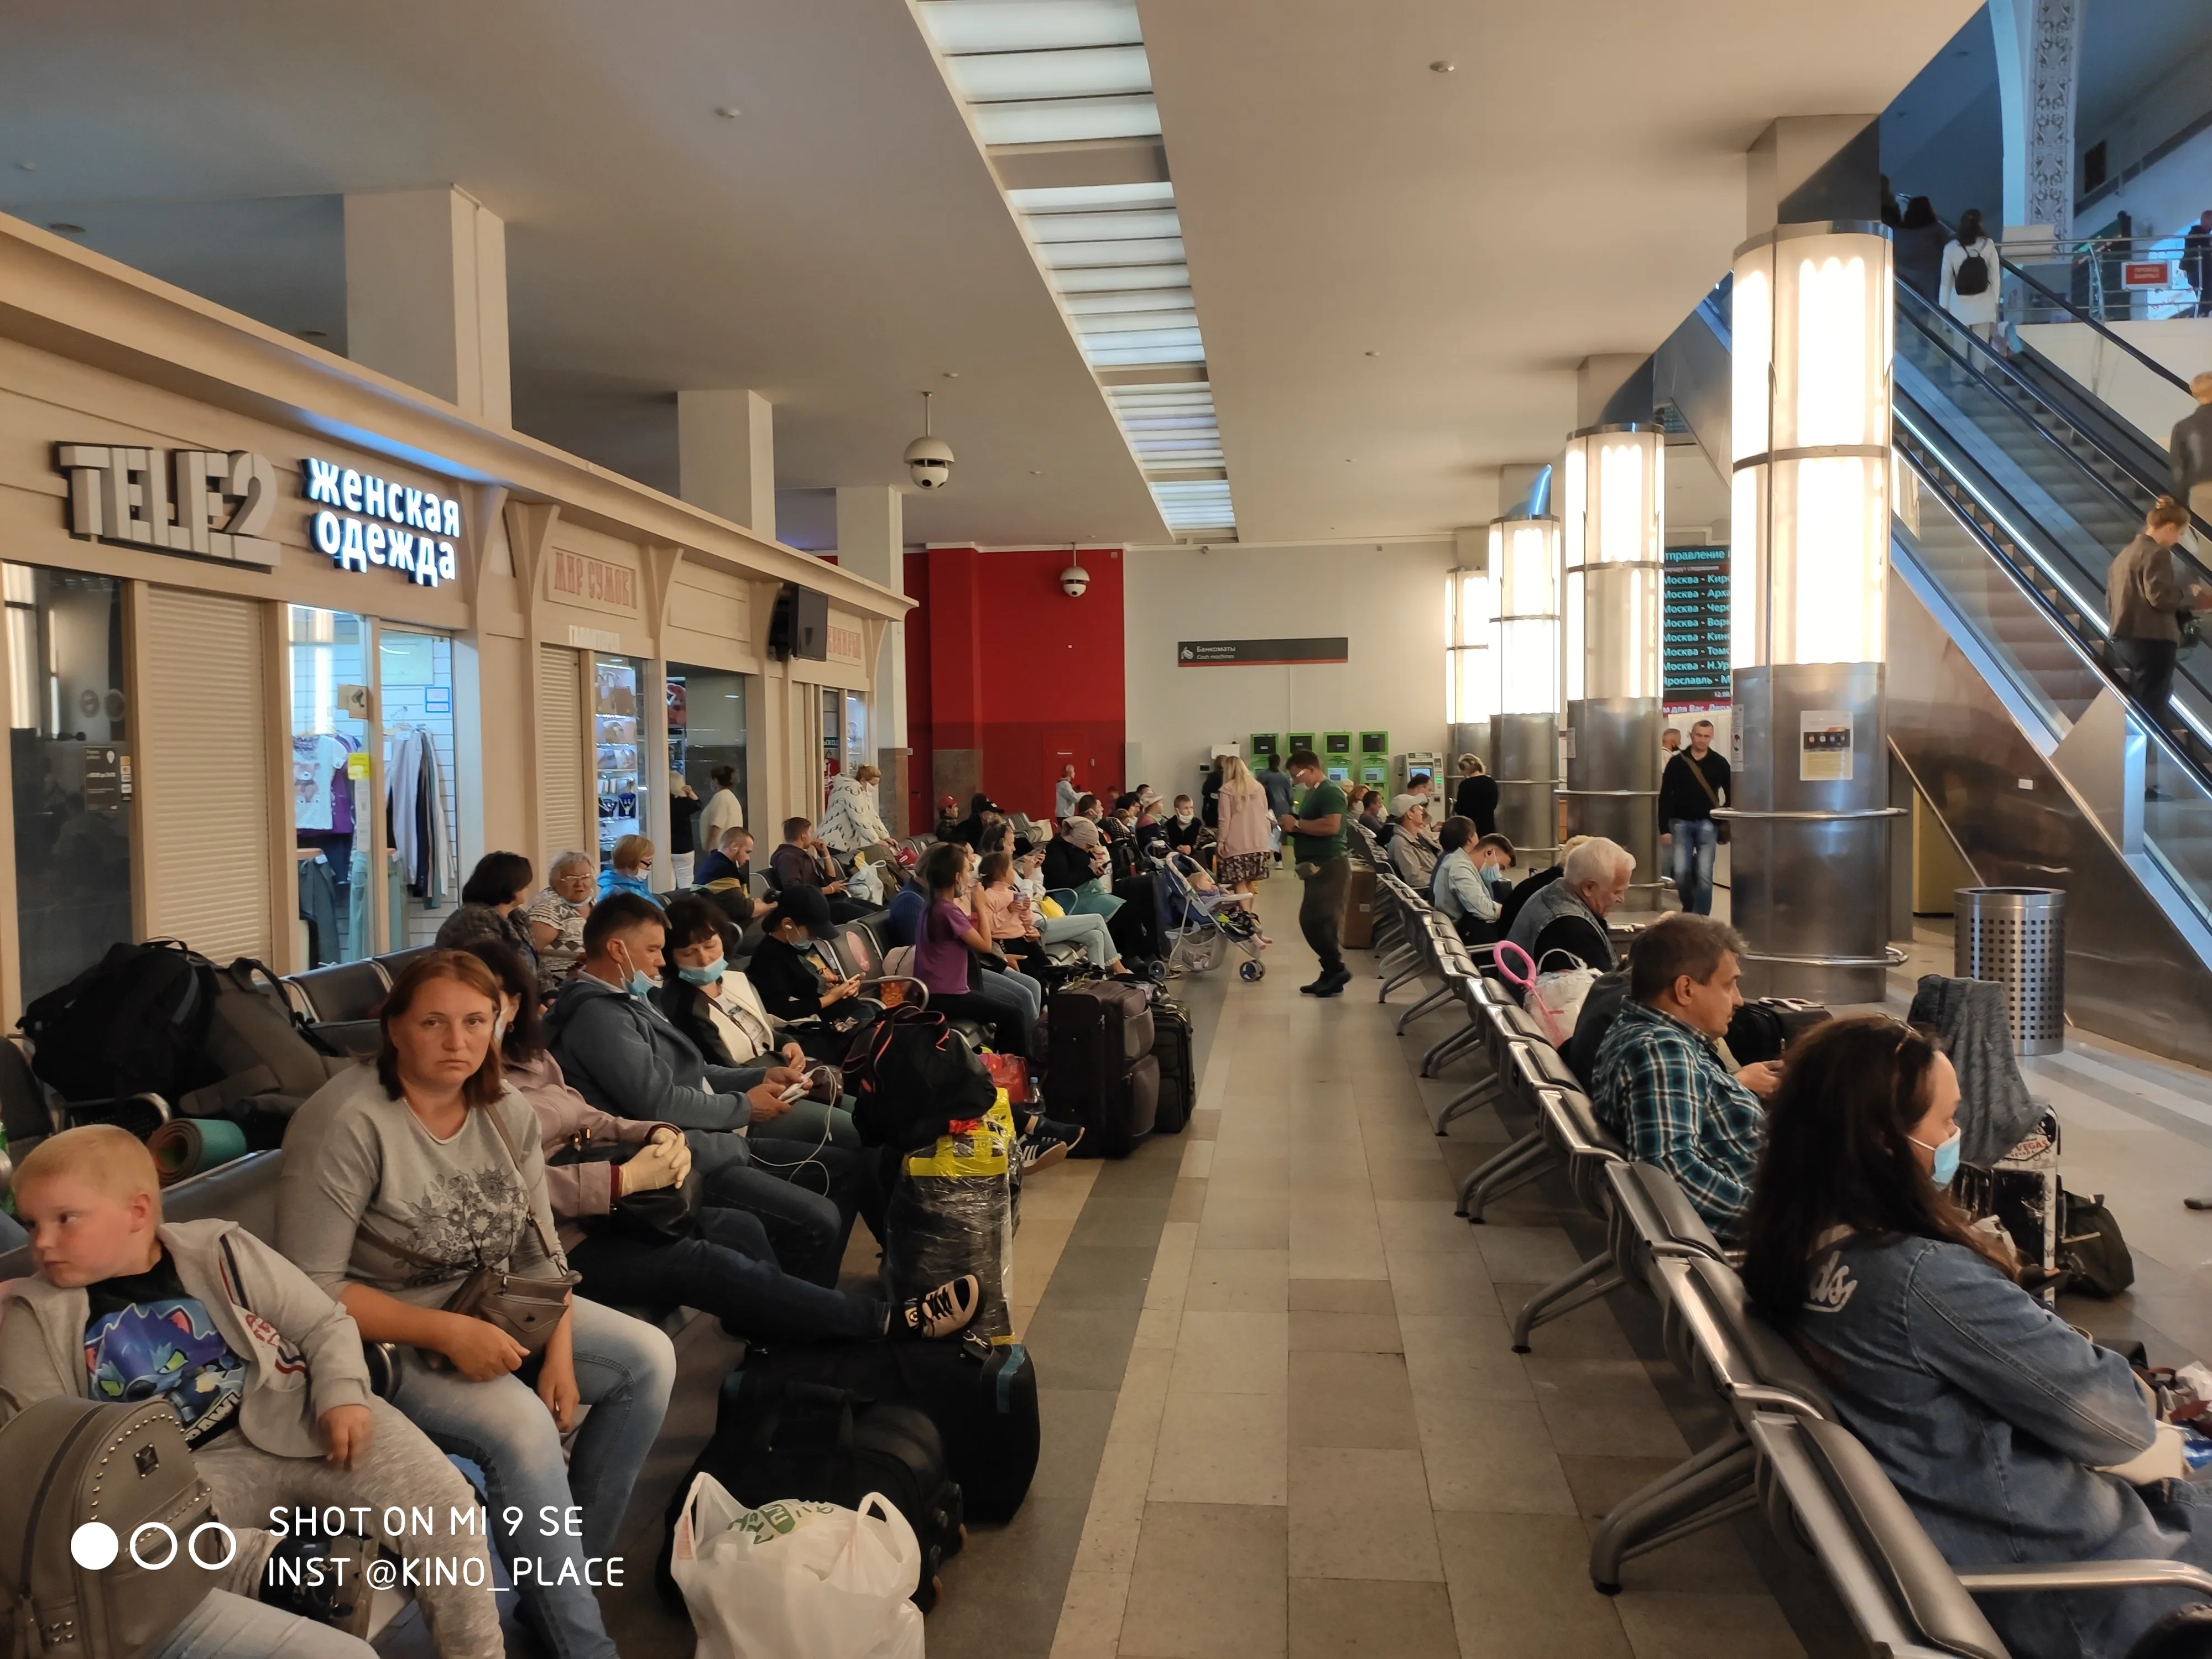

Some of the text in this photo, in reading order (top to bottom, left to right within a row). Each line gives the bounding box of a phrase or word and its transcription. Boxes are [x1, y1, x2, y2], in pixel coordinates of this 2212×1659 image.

[56, 445, 281, 568] TELE2
[311, 457, 460, 538] женская
[318, 512, 456, 587] одежда
[1665, 551, 1725, 562] тправление
